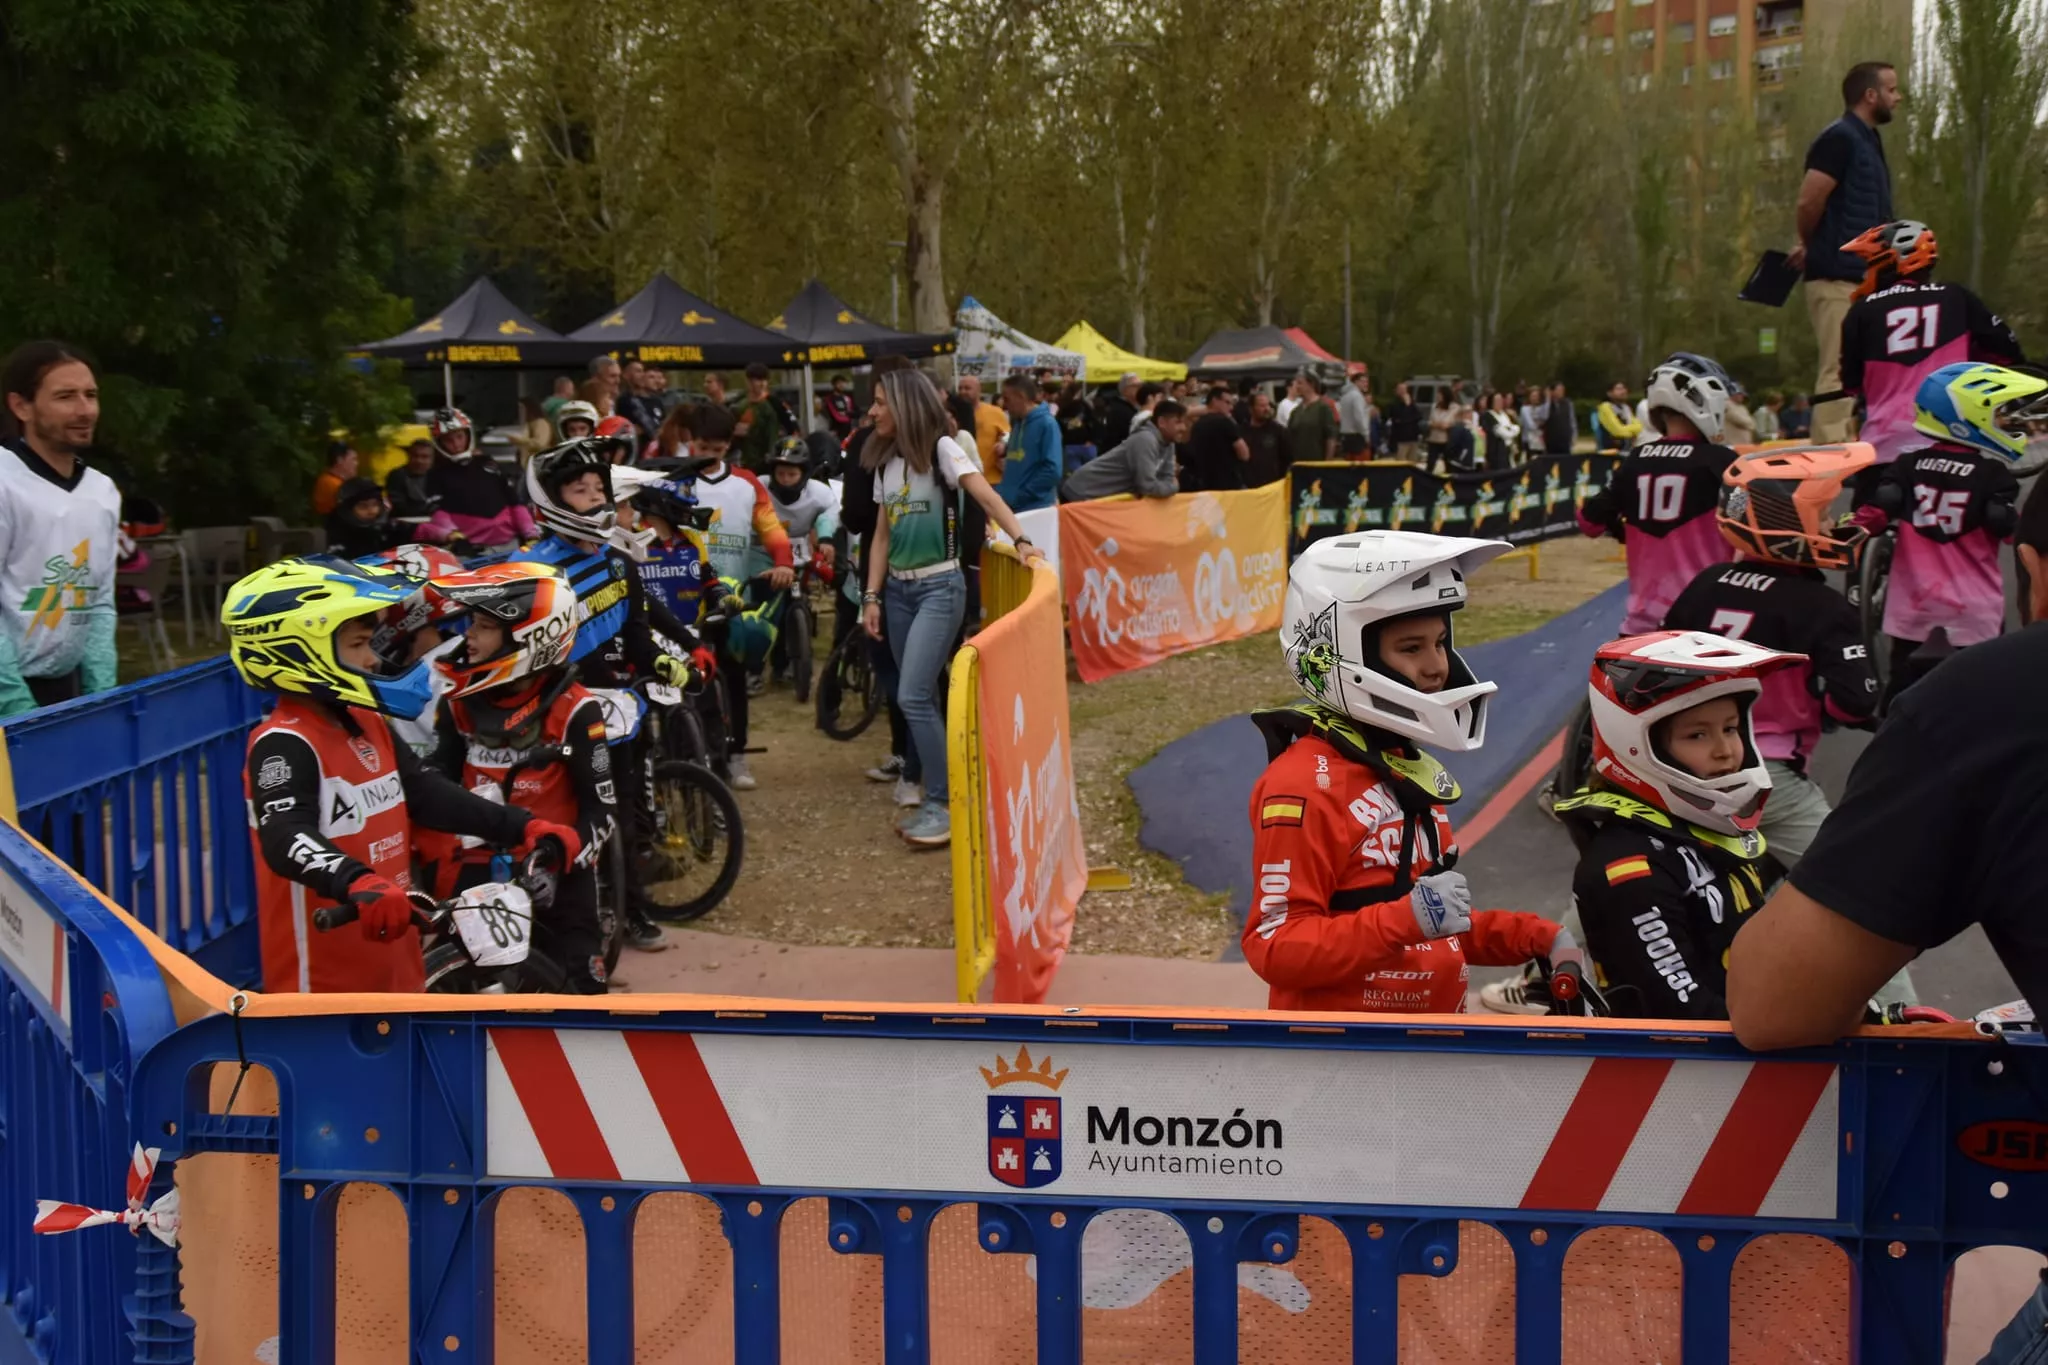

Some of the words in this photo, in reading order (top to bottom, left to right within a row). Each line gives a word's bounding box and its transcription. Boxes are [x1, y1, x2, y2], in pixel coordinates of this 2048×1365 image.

[1886, 304, 1940, 355] 21
[1639, 445, 1694, 459] DAVID
[1637, 474, 1688, 520] 10
[1912, 484, 1972, 535] 25
[637, 564, 687, 579] Allianz
[1355, 560, 1411, 573] LEATT
[1717, 569, 1777, 592] LUKI
[521, 606, 573, 654] TROY
[1709, 608, 1755, 642] 7
[478, 898, 524, 949] 88
[1377, 969, 1435, 981] SCOTT
[1363, 988, 1422, 1002] REGALOS
[1087, 1105, 1283, 1149] Monzón
[1087, 1149, 1283, 1176] Ayuntamiento
